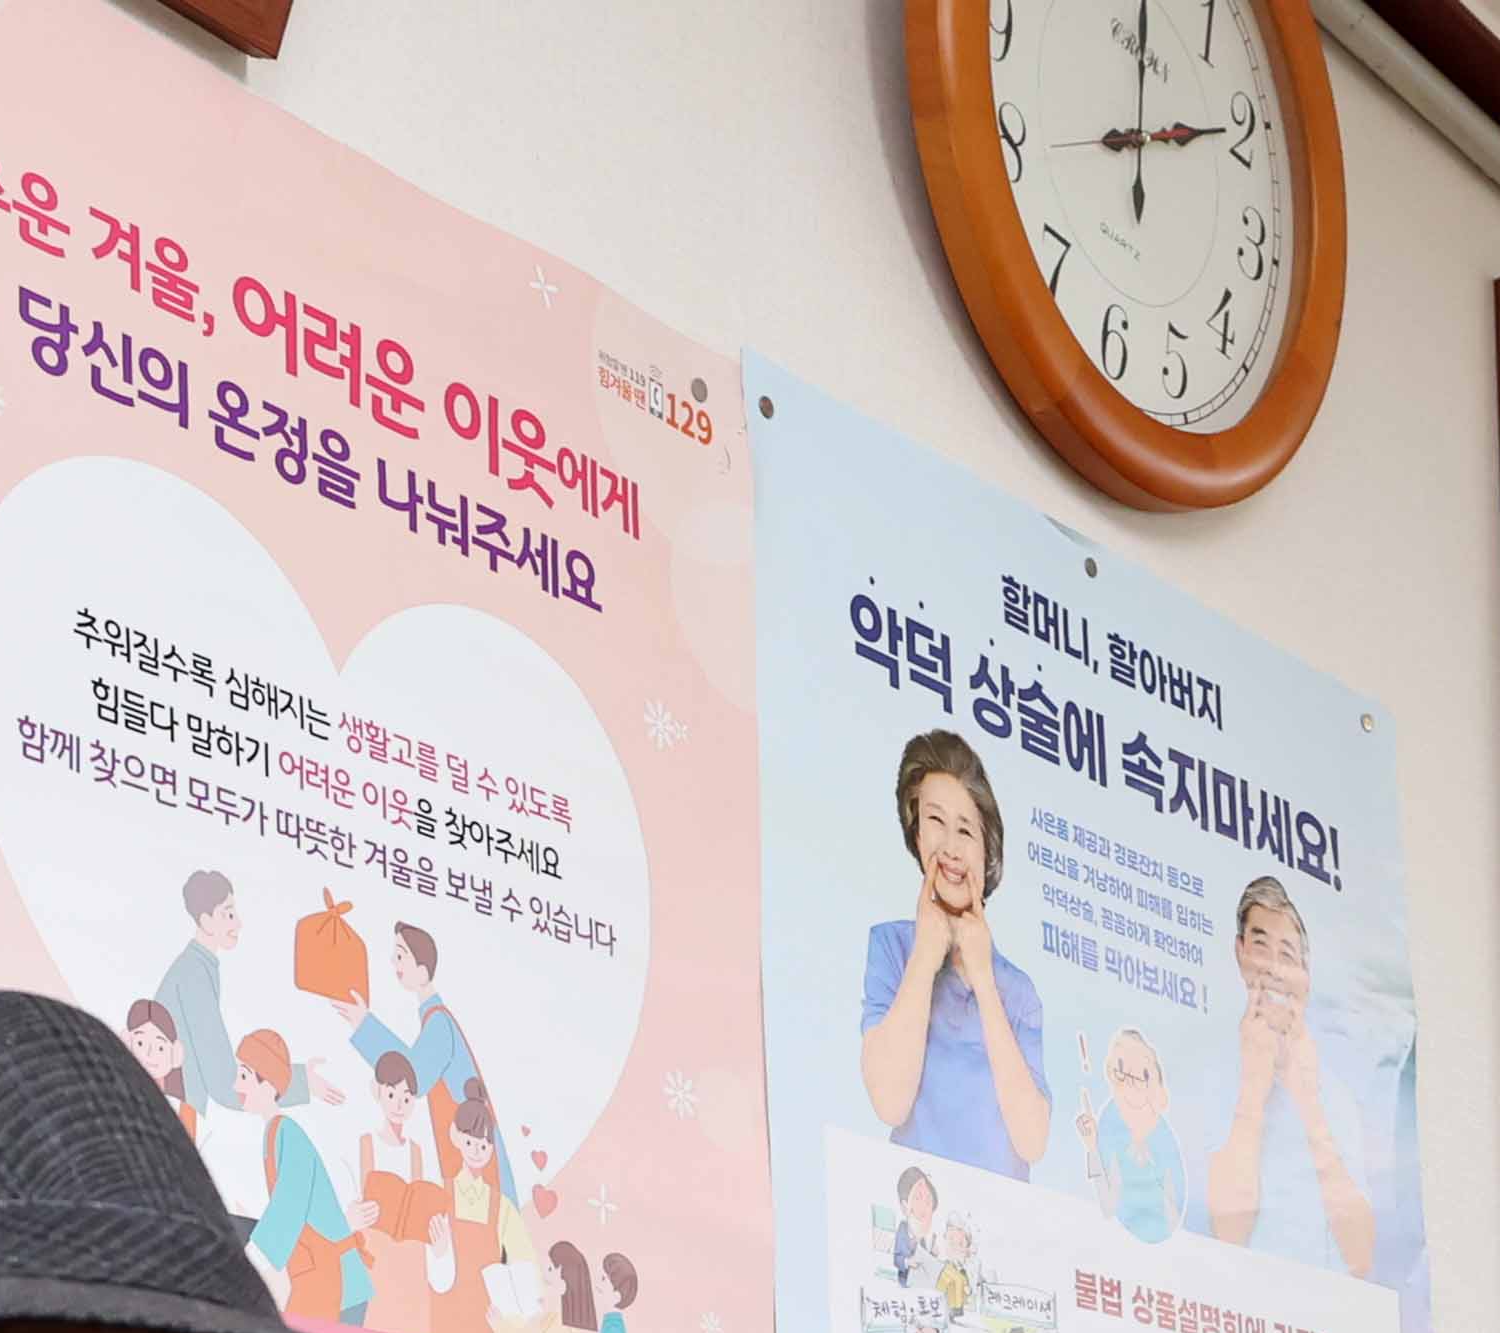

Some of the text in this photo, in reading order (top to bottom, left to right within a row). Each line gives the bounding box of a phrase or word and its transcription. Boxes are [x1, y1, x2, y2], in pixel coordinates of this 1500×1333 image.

[1229, 91, 1256, 169] 2
[1237, 206, 1266, 281] 3
[1101, 304, 1129, 380] 6
[1162, 321, 1189, 399] 5
[1206, 288, 1235, 360] 4
[89, 207, 214, 337] 겨울,
[233, 276, 425, 439] 어려운
[444, 382, 640, 540] 이웃에게
[18, 285, 602, 612] 당신의 온정을 나눠주세요
[666, 393, 712, 445] 129
[1001, 575, 1223, 731] 할머니, 할아버지
[73, 608, 572, 833] 추워질수록 심해지는 생활고를 덜 수 있도록
[850, 594, 1343, 894] 악덕 상술에 속지마세요!
[91, 677, 562, 880] 힘들다 말하기 어려운 이웃을 찾아주세요
[17, 714, 617, 957] 함께 찾으면 모두가 따뜻한 겨울을 보낼 수 있습니다
[1041, 920, 1198, 1009] 피해를 막아보세요
[1074, 1269, 1124, 1319] 불법
